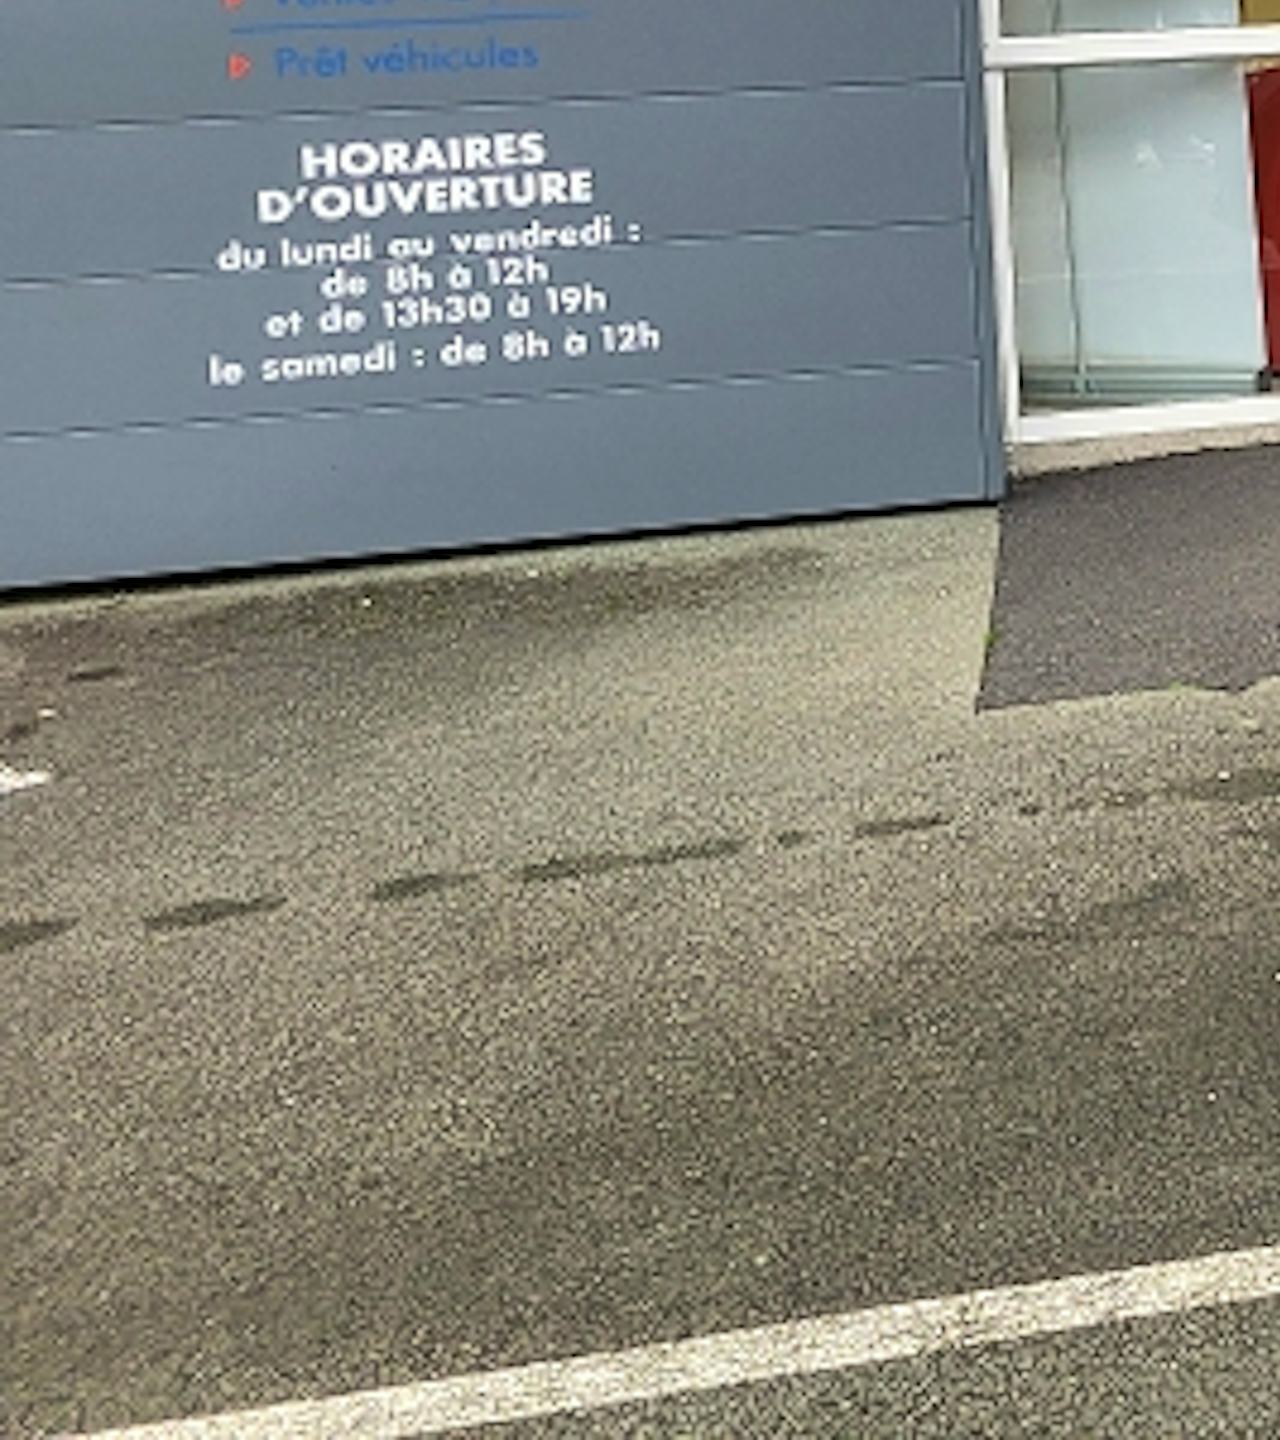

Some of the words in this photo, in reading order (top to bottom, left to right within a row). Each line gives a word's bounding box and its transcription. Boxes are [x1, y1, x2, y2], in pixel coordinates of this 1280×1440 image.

[275, 44, 348, 80] Prêt
[363, 37, 540, 73] véhicules
[300, 131, 548, 180] HORAIRES
[256, 169, 595, 224] D'OUVERTURE
[217, 240, 266, 271] du
[280, 234, 373, 268] lundi
[388, 234, 435, 259] au
[450, 214, 613, 251] vendredi
[320, 269, 368, 300] de
[386, 262, 434, 294] 8h
[448, 258, 473, 290] à
[487, 255, 550, 287] 12h
[265, 310, 302, 338] et
[319, 304, 366, 335] de
[382, 293, 492, 329] 13h30
[507, 287, 531, 320] à
[545, 283, 608, 316] 19h
[208, 355, 245, 387] le
[261, 341, 397, 382] samedi
[440, 336, 486, 368] de
[503, 330, 549, 362] 8h
[564, 324, 588, 358] à
[602, 320, 661, 353] 12h
